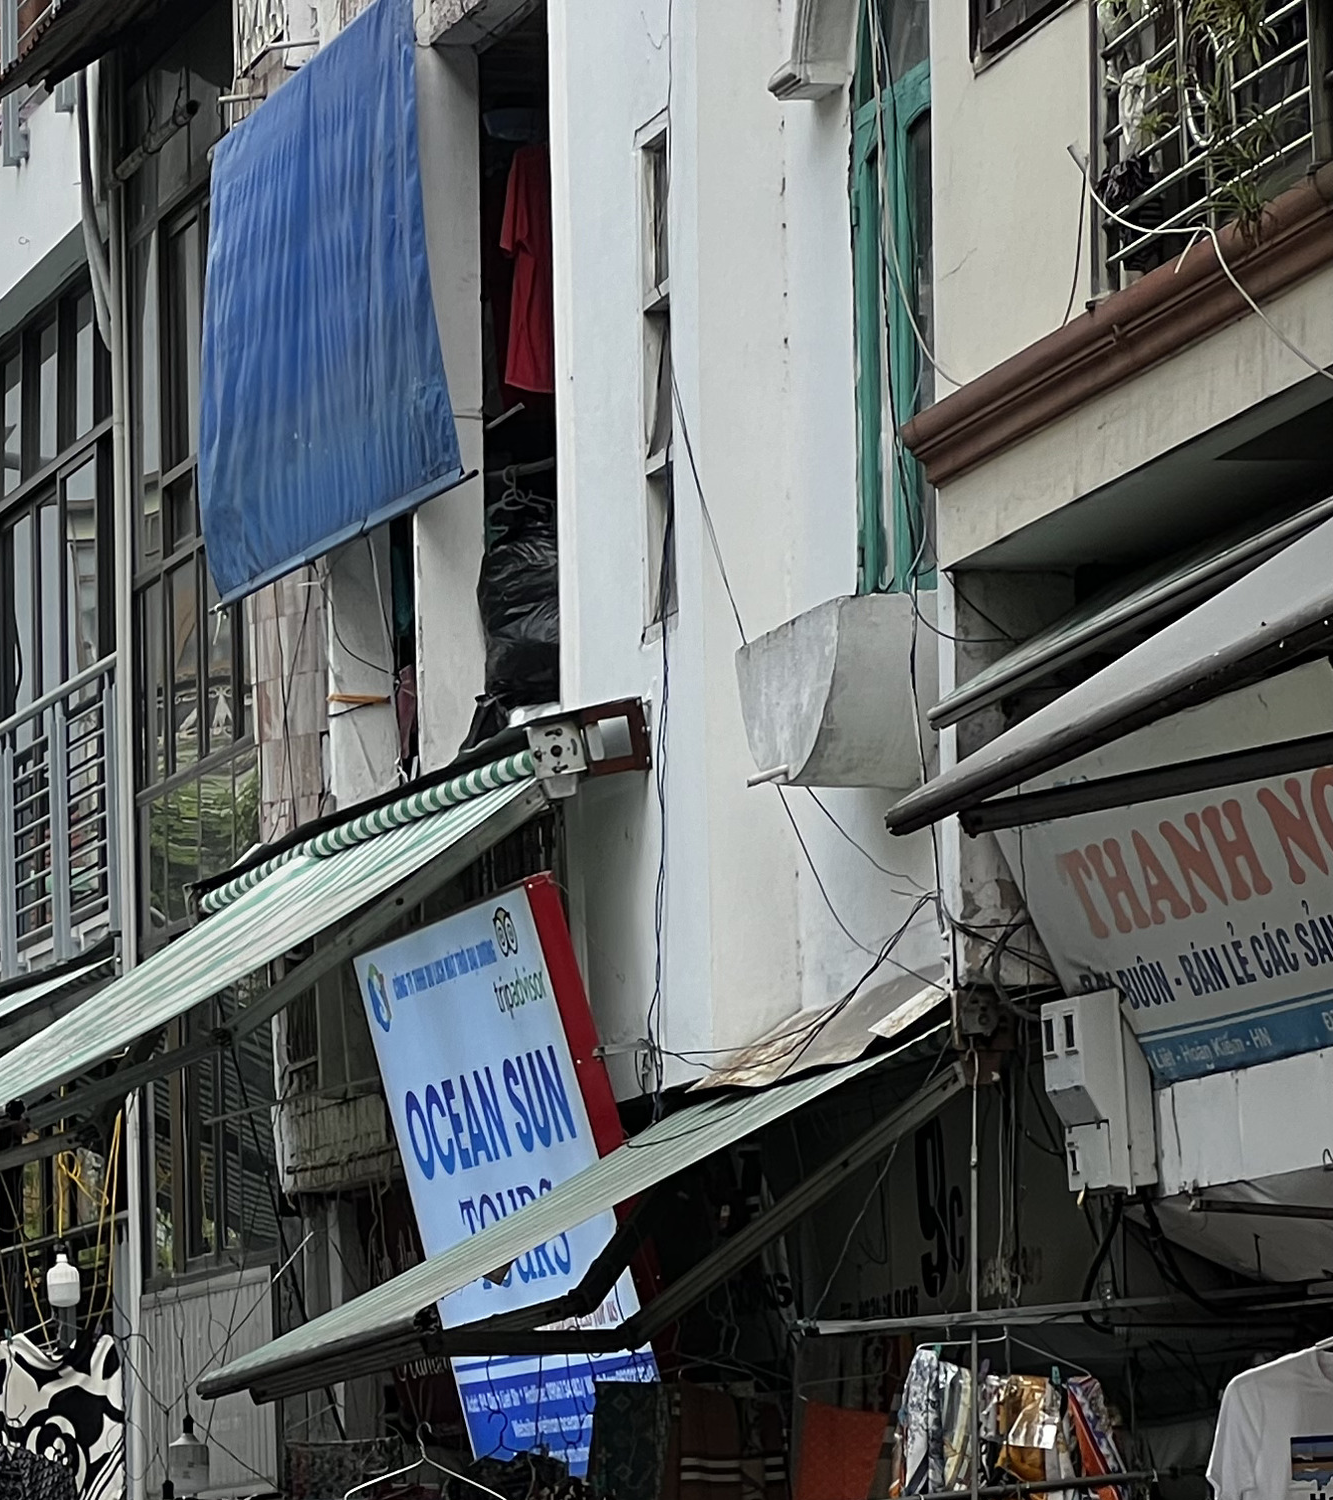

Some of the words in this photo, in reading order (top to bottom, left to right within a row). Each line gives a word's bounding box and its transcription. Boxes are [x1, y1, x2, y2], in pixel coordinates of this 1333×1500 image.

[1056, 799, 1273, 940] THANH
[493, 964, 547, 1020] tripadvisor
[1179, 942, 1230, 997] BÁN
[1221, 921, 1256, 986] LẺ
[1250, 921, 1300, 979] CÁC
[405, 1066, 512, 1180] OCEAN
[502, 1045, 577, 1153] SUN
